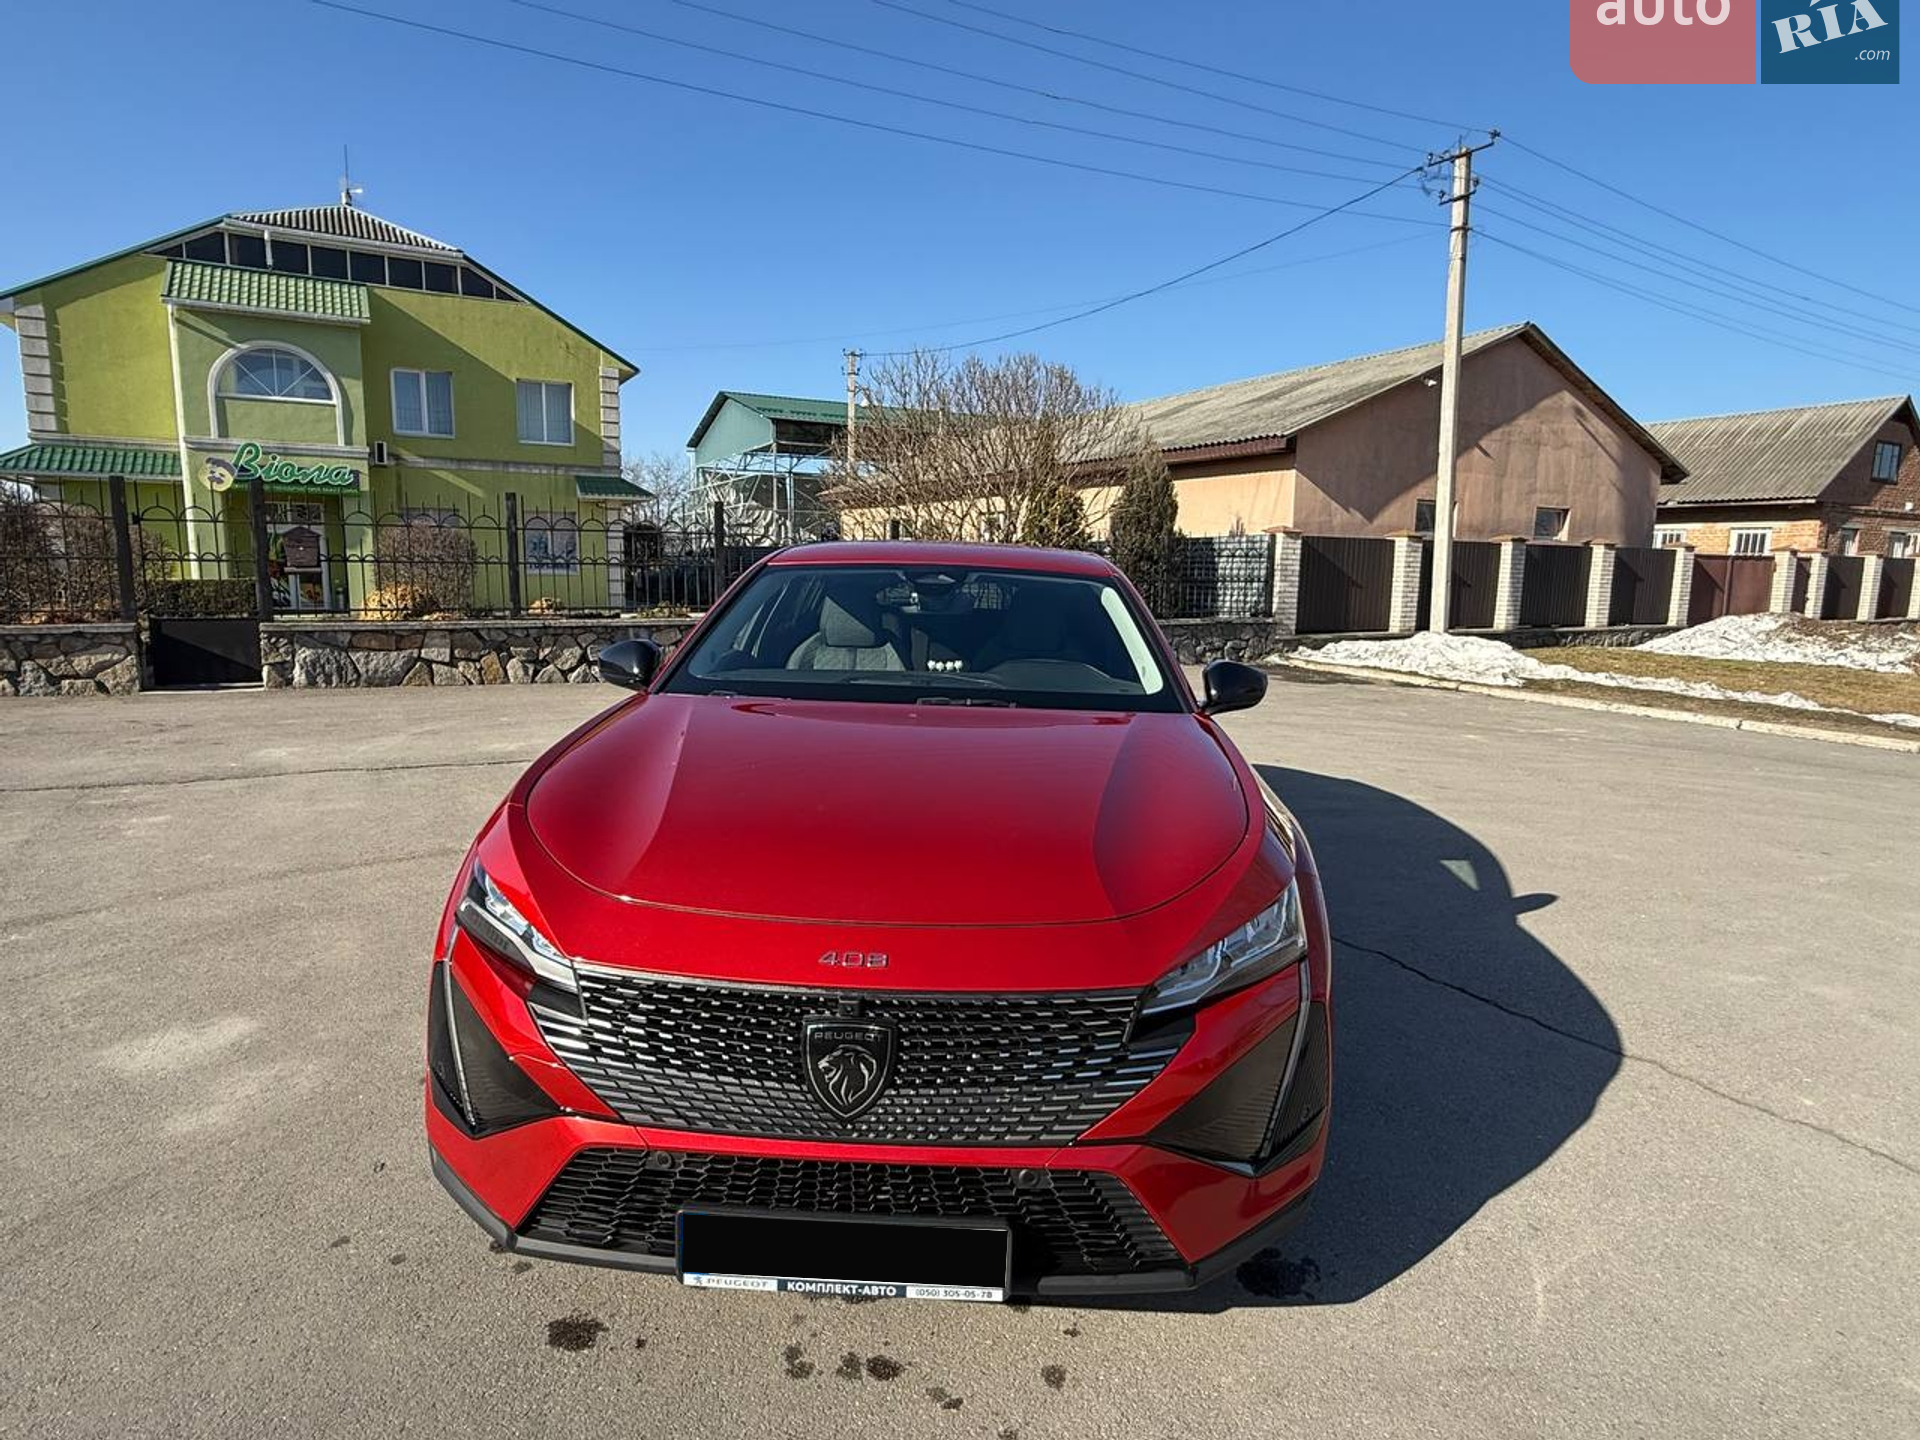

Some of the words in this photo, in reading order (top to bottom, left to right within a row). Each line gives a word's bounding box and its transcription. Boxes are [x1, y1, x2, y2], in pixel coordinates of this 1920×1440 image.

[818, 950, 889, 969] 408
[814, 1031, 881, 1041] PEUGEOT
[786, 1280, 897, 1297] КОМПЛЕКТ-АВТО
[915, 1287, 941, 1297] (050)
[943, 1289, 993, 1299] 305-05-78
